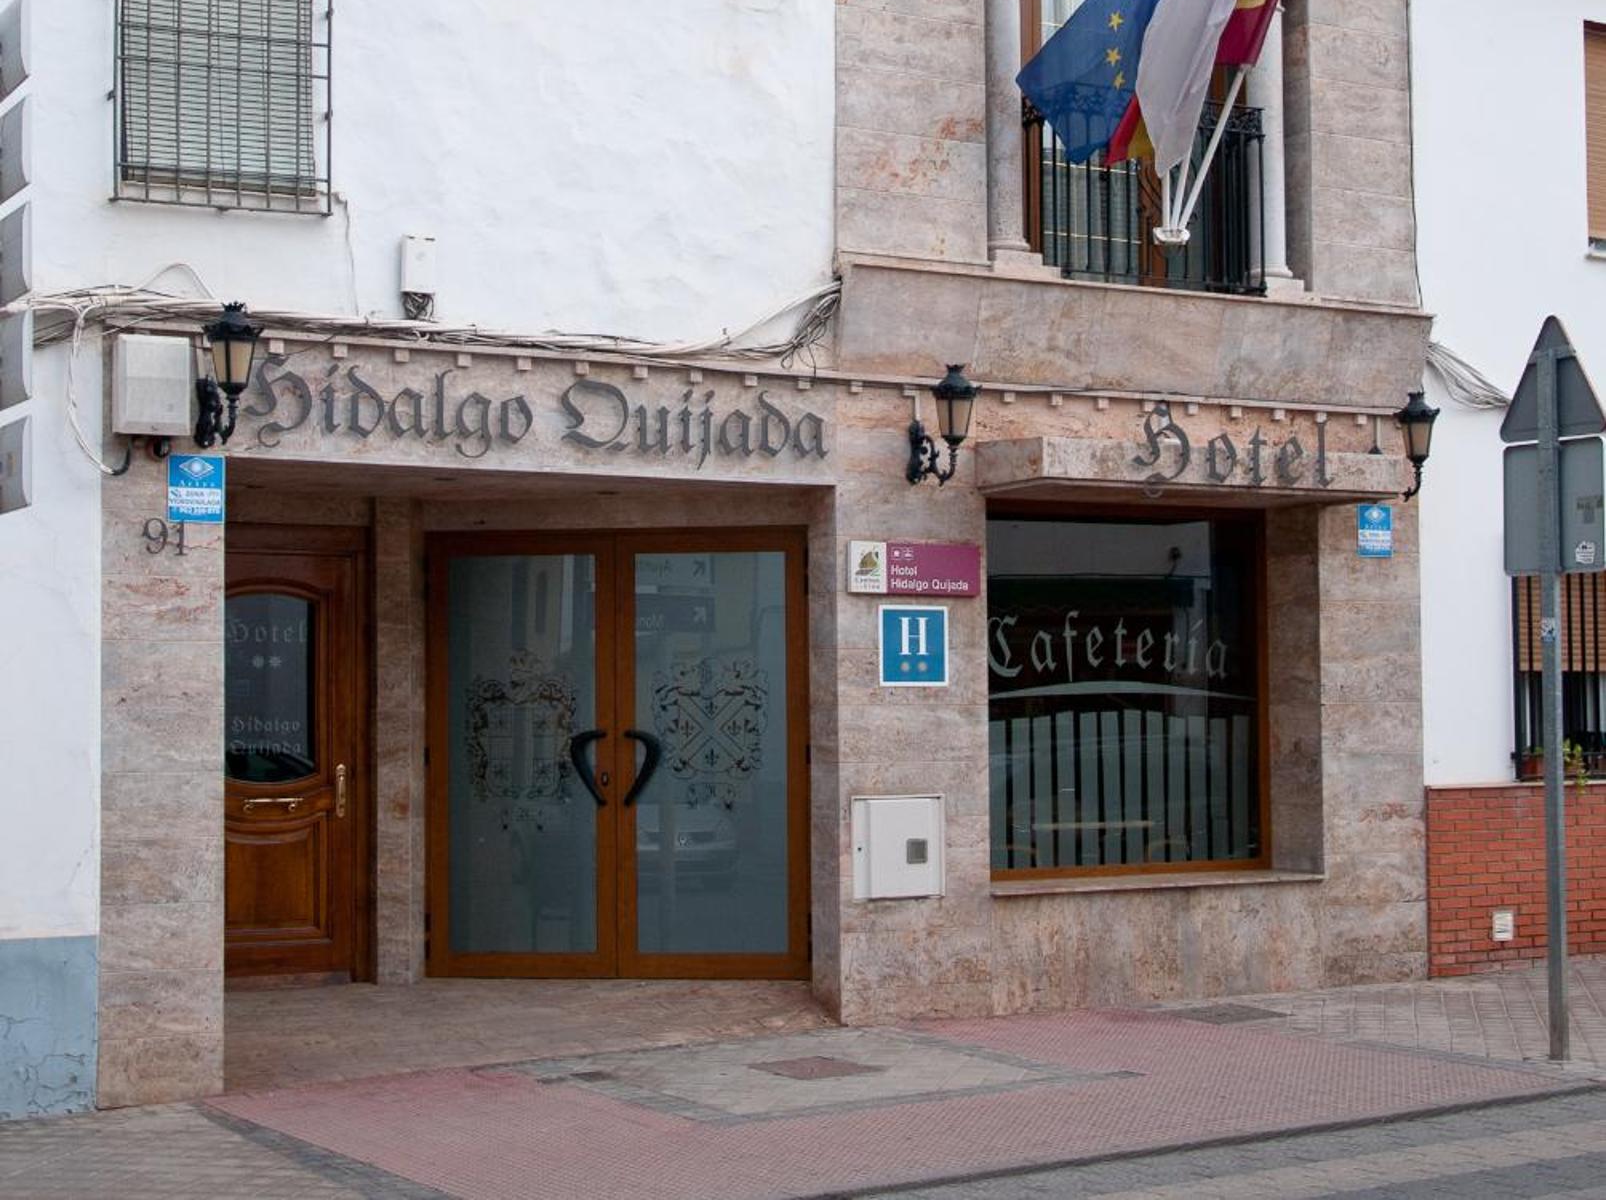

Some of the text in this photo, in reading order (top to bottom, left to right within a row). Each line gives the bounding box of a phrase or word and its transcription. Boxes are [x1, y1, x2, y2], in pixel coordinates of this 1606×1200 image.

[242, 355, 829, 469] Hidalgo Quijada
[1132, 400, 1334, 497] Hotel
[141, 517, 187, 556] 91
[891, 565, 917, 576] Hotel
[891, 579, 928, 591] Hidalgo
[900, 617, 928, 656] H
